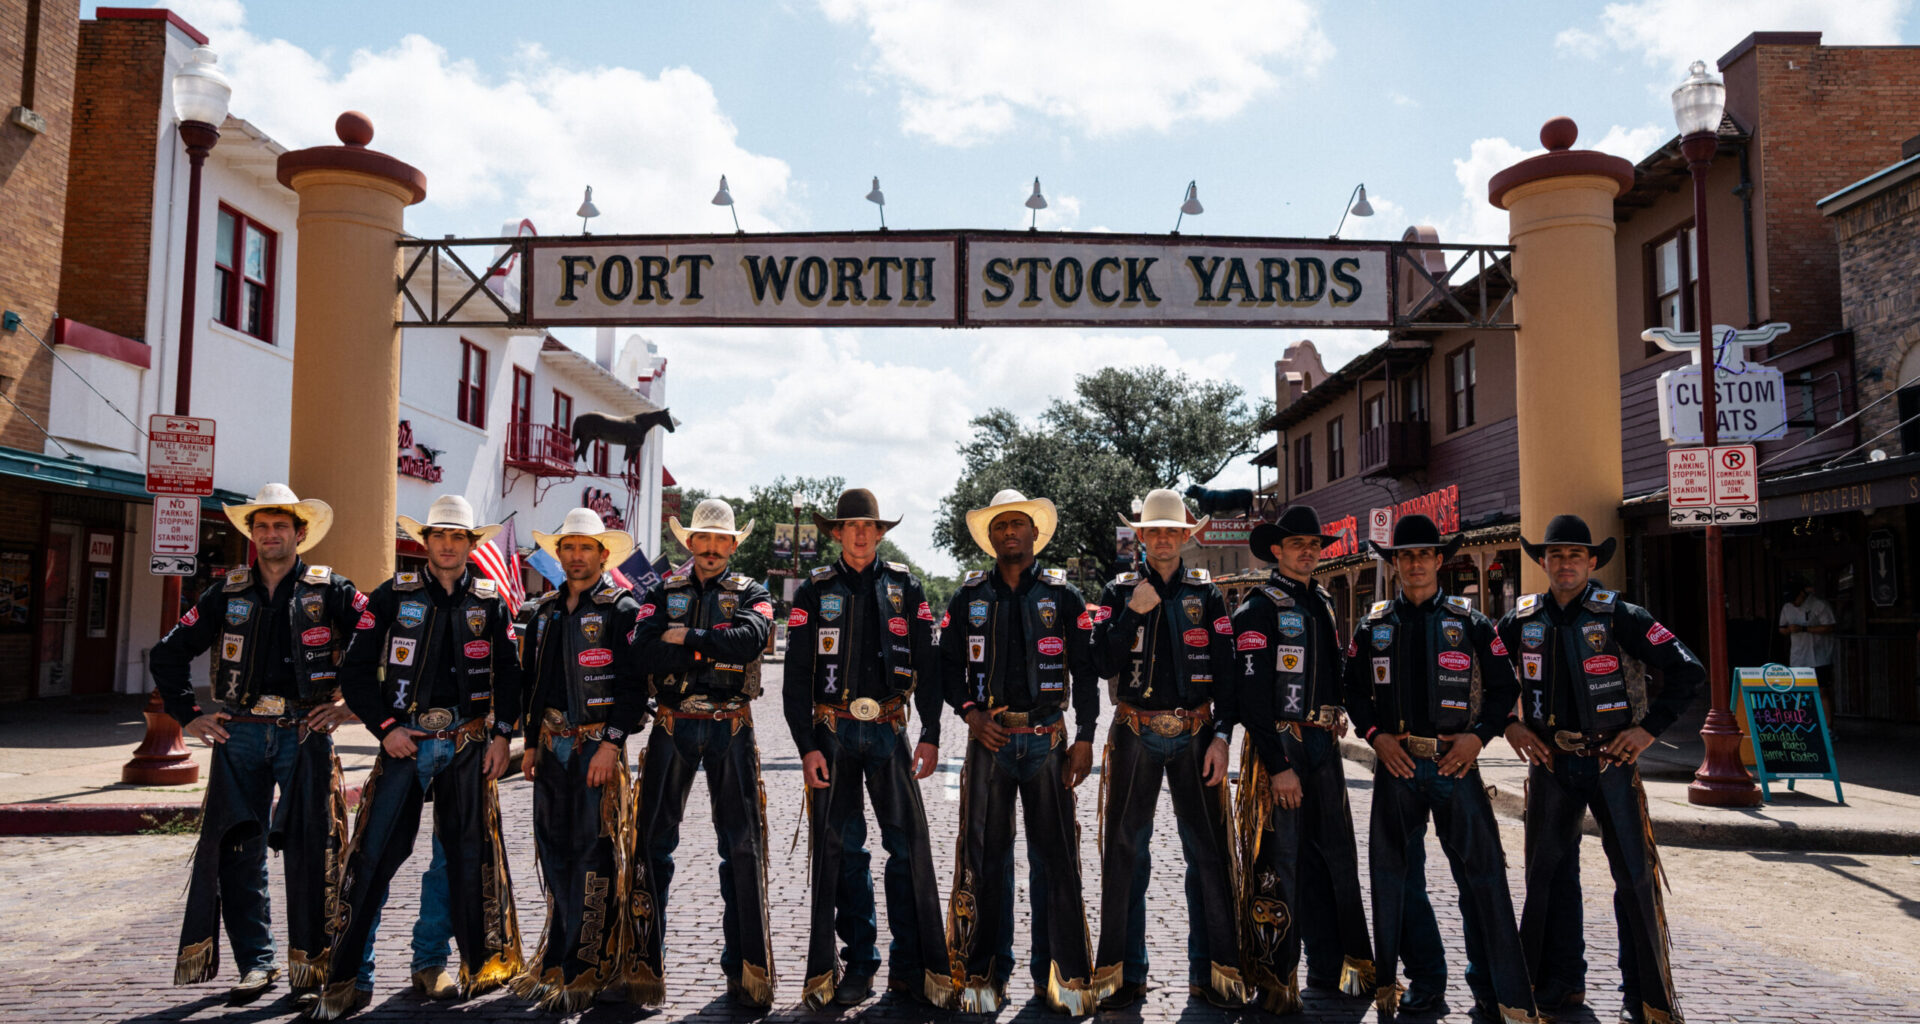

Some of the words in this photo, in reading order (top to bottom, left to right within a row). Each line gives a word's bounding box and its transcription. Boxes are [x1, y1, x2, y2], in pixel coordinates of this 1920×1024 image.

[557, 254, 714, 305] FORT
[740, 254, 937, 306] WORTH
[983, 256, 1162, 306] STOCK
[1186, 255, 1363, 306] YARDS
[1676, 380, 1776, 406] CUSTOM
[155, 441, 176, 450] VALET
[179, 443, 209, 453] PARKING
[1681, 453, 1696, 462] NO
[1673, 462, 1705, 470] PARKING
[1672, 470, 1707, 479] STOPPING
[1716, 470, 1752, 478] COMMERCIAL
[1721, 479, 1745, 487] LOADING
[1672, 486, 1708, 494] STANDING
[1727, 486, 1742, 494] ZONE
[1799, 483, 1872, 513] WESTERN
[170, 500, 185, 509] NO
[160, 509, 193, 518] PARKING
[159, 517, 194, 526] STOPPING
[1211, 521, 1256, 530] RISCKY'S
[171, 526, 181, 534] OR
[157, 533, 194, 542] STANDING
[91, 541, 112, 556] ATM
[1276, 576, 1297, 589] ARIAT
[401, 610, 422, 618] WORLD
[789, 614, 806, 623] unity
[1278, 647, 1304, 655] ARIAT
[580, 654, 611, 666] Community
[1440, 655, 1469, 667] Community
[1585, 659, 1617, 670] Community
[1594, 680, 1622, 690] Land.com
[1750, 693, 1801, 710] HAPPY
[577, 871, 609, 966] ARIAT
